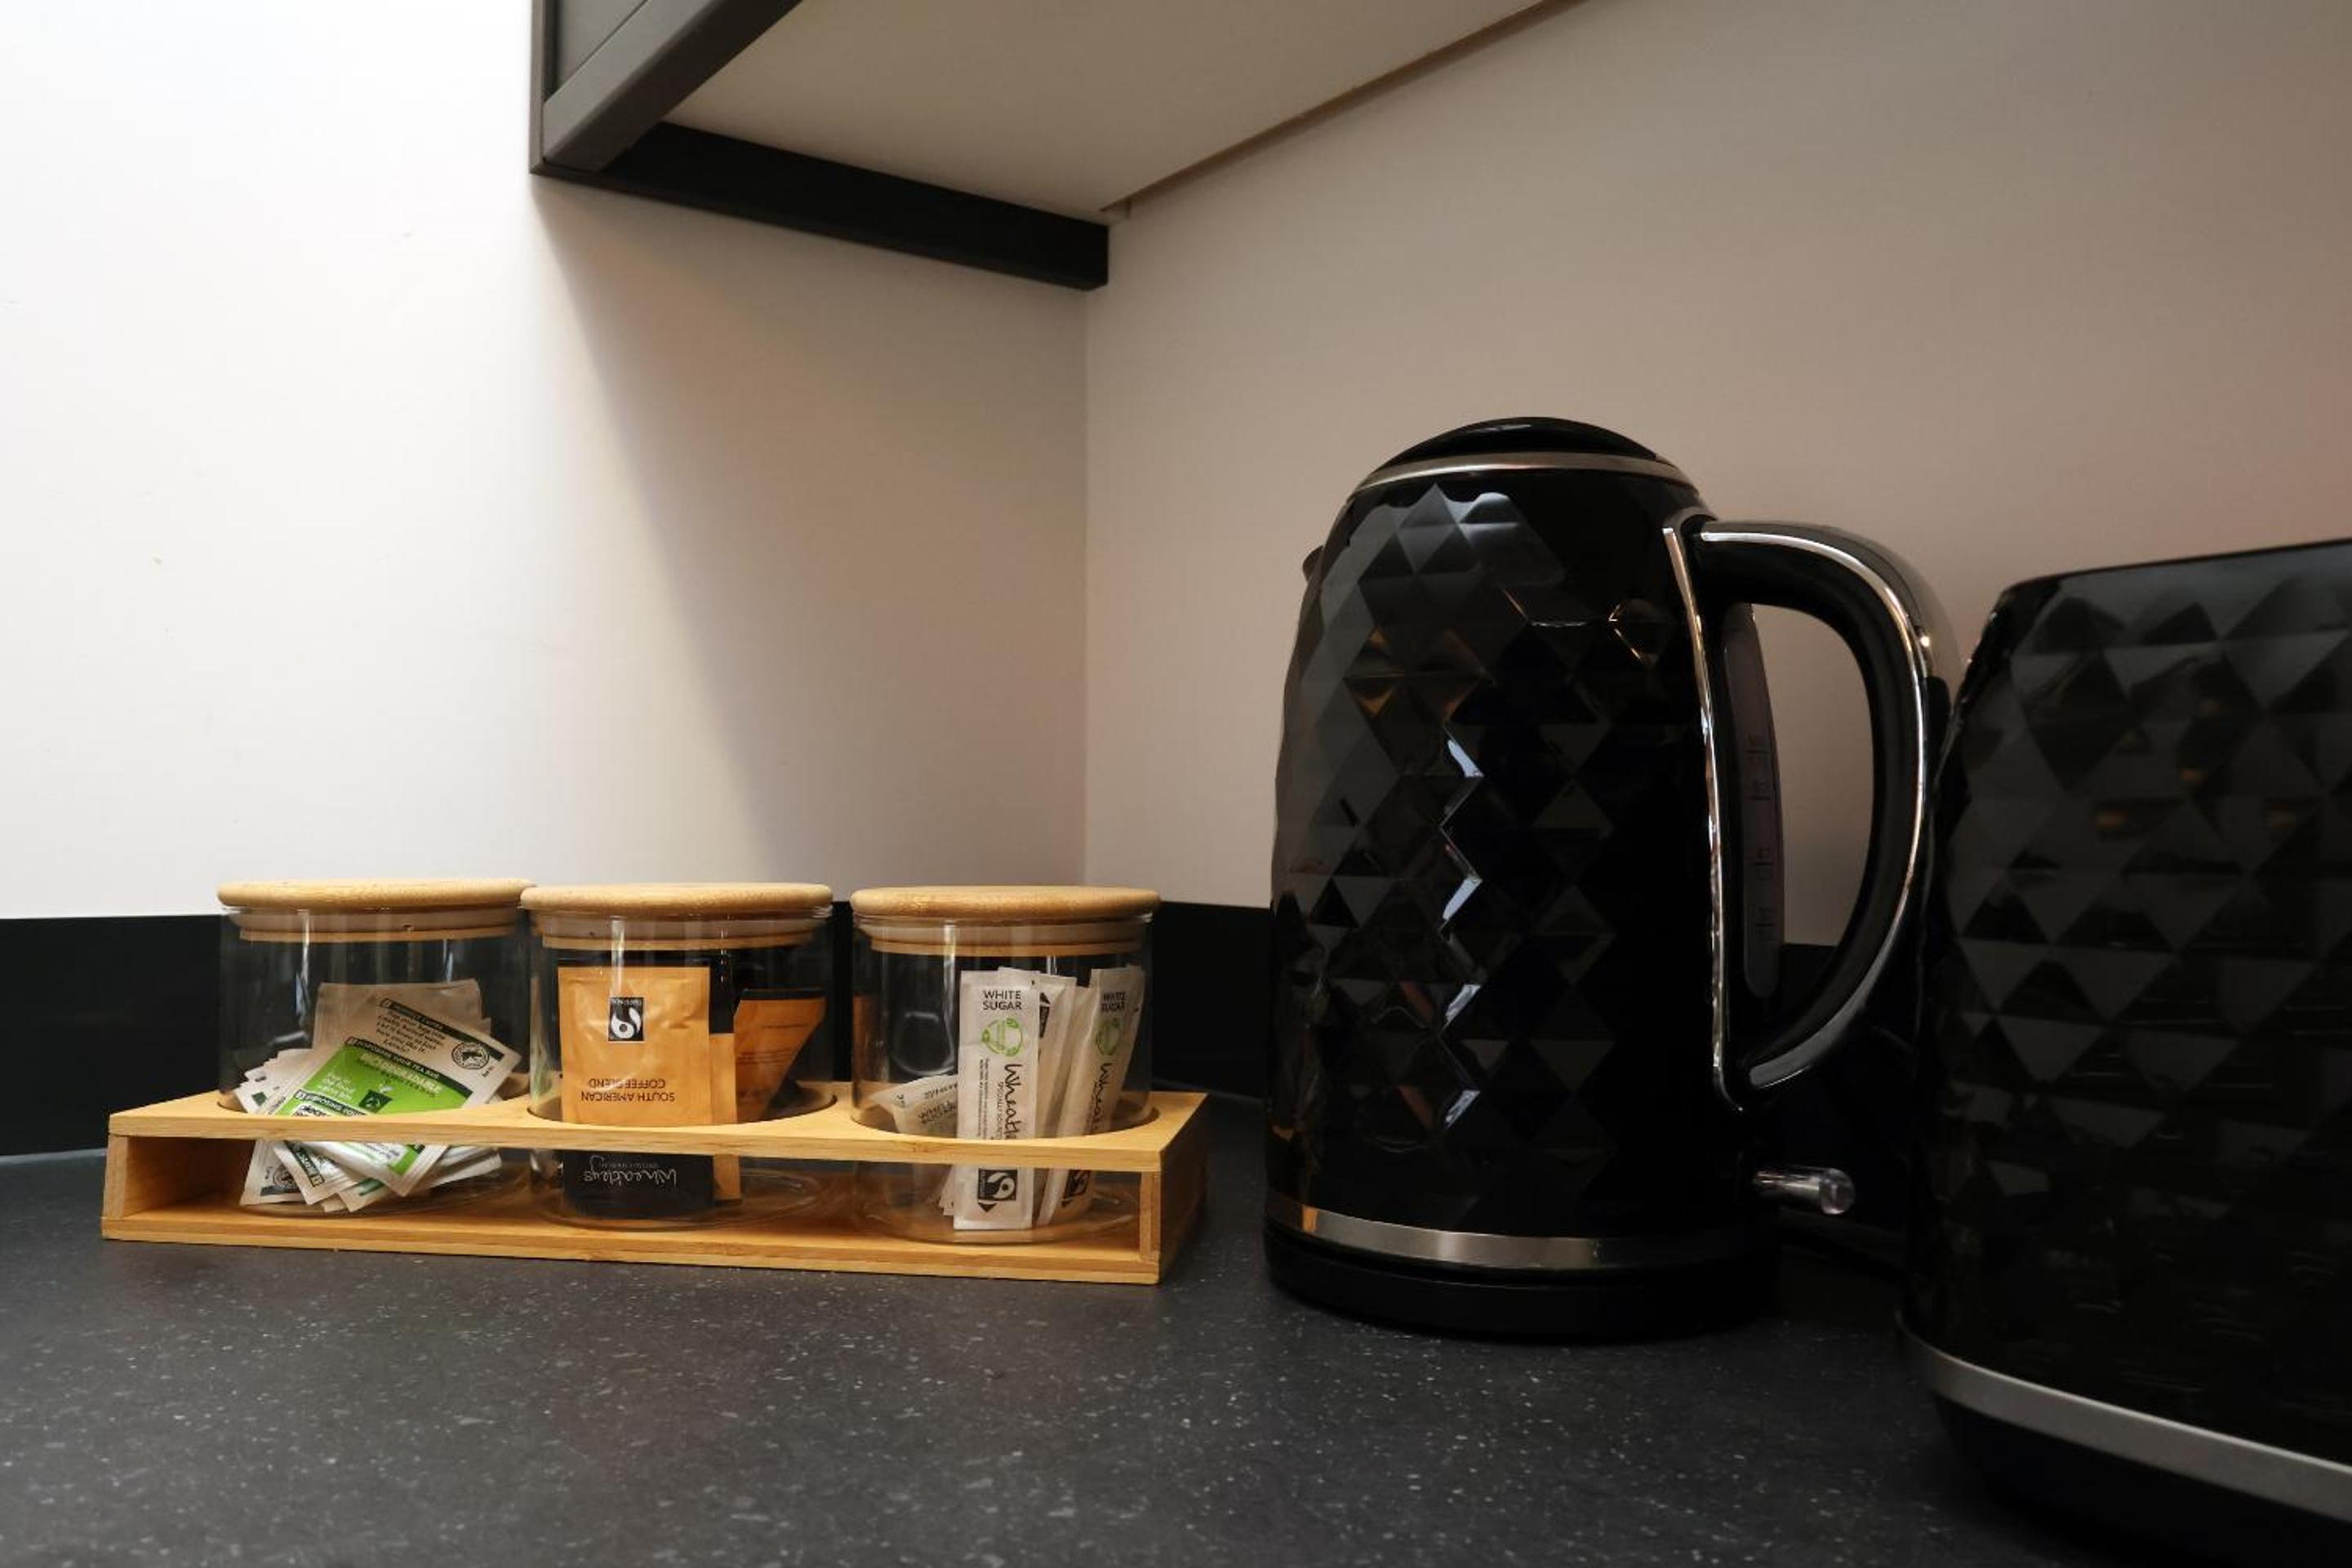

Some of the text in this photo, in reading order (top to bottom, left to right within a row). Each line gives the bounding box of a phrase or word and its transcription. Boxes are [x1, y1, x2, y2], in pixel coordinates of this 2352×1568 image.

[982, 990, 1021, 999] WHITE
[1103, 992, 1126, 1001] WHITE
[982, 1001, 1022, 1011] SUGAR
[1101, 1002, 1125, 1012] SUGAR
[625, 1078, 666, 1089] COFFEE
[580, 1090, 675, 1101] SOUTH AMERICAN
[584, 1154, 677, 1187] Wheatleys
